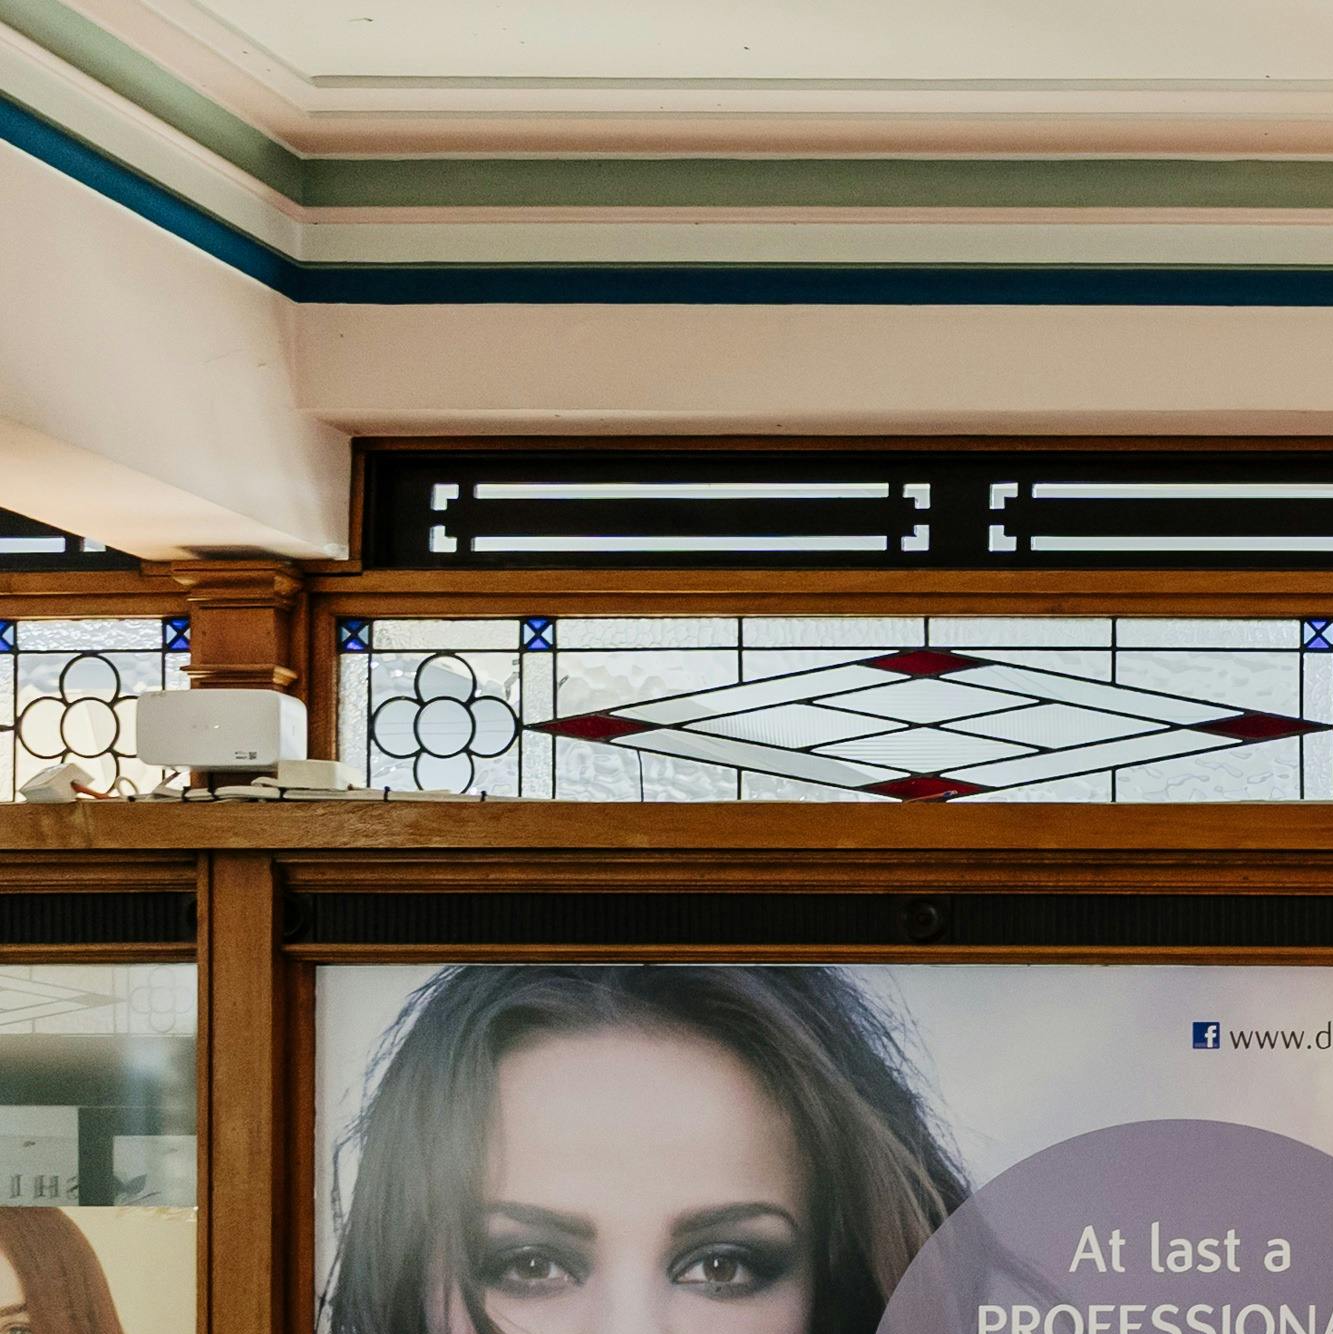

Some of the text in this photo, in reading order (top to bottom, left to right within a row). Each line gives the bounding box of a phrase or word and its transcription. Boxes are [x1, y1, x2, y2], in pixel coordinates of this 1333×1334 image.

[1069, 1222, 1292, 1274] At last a
